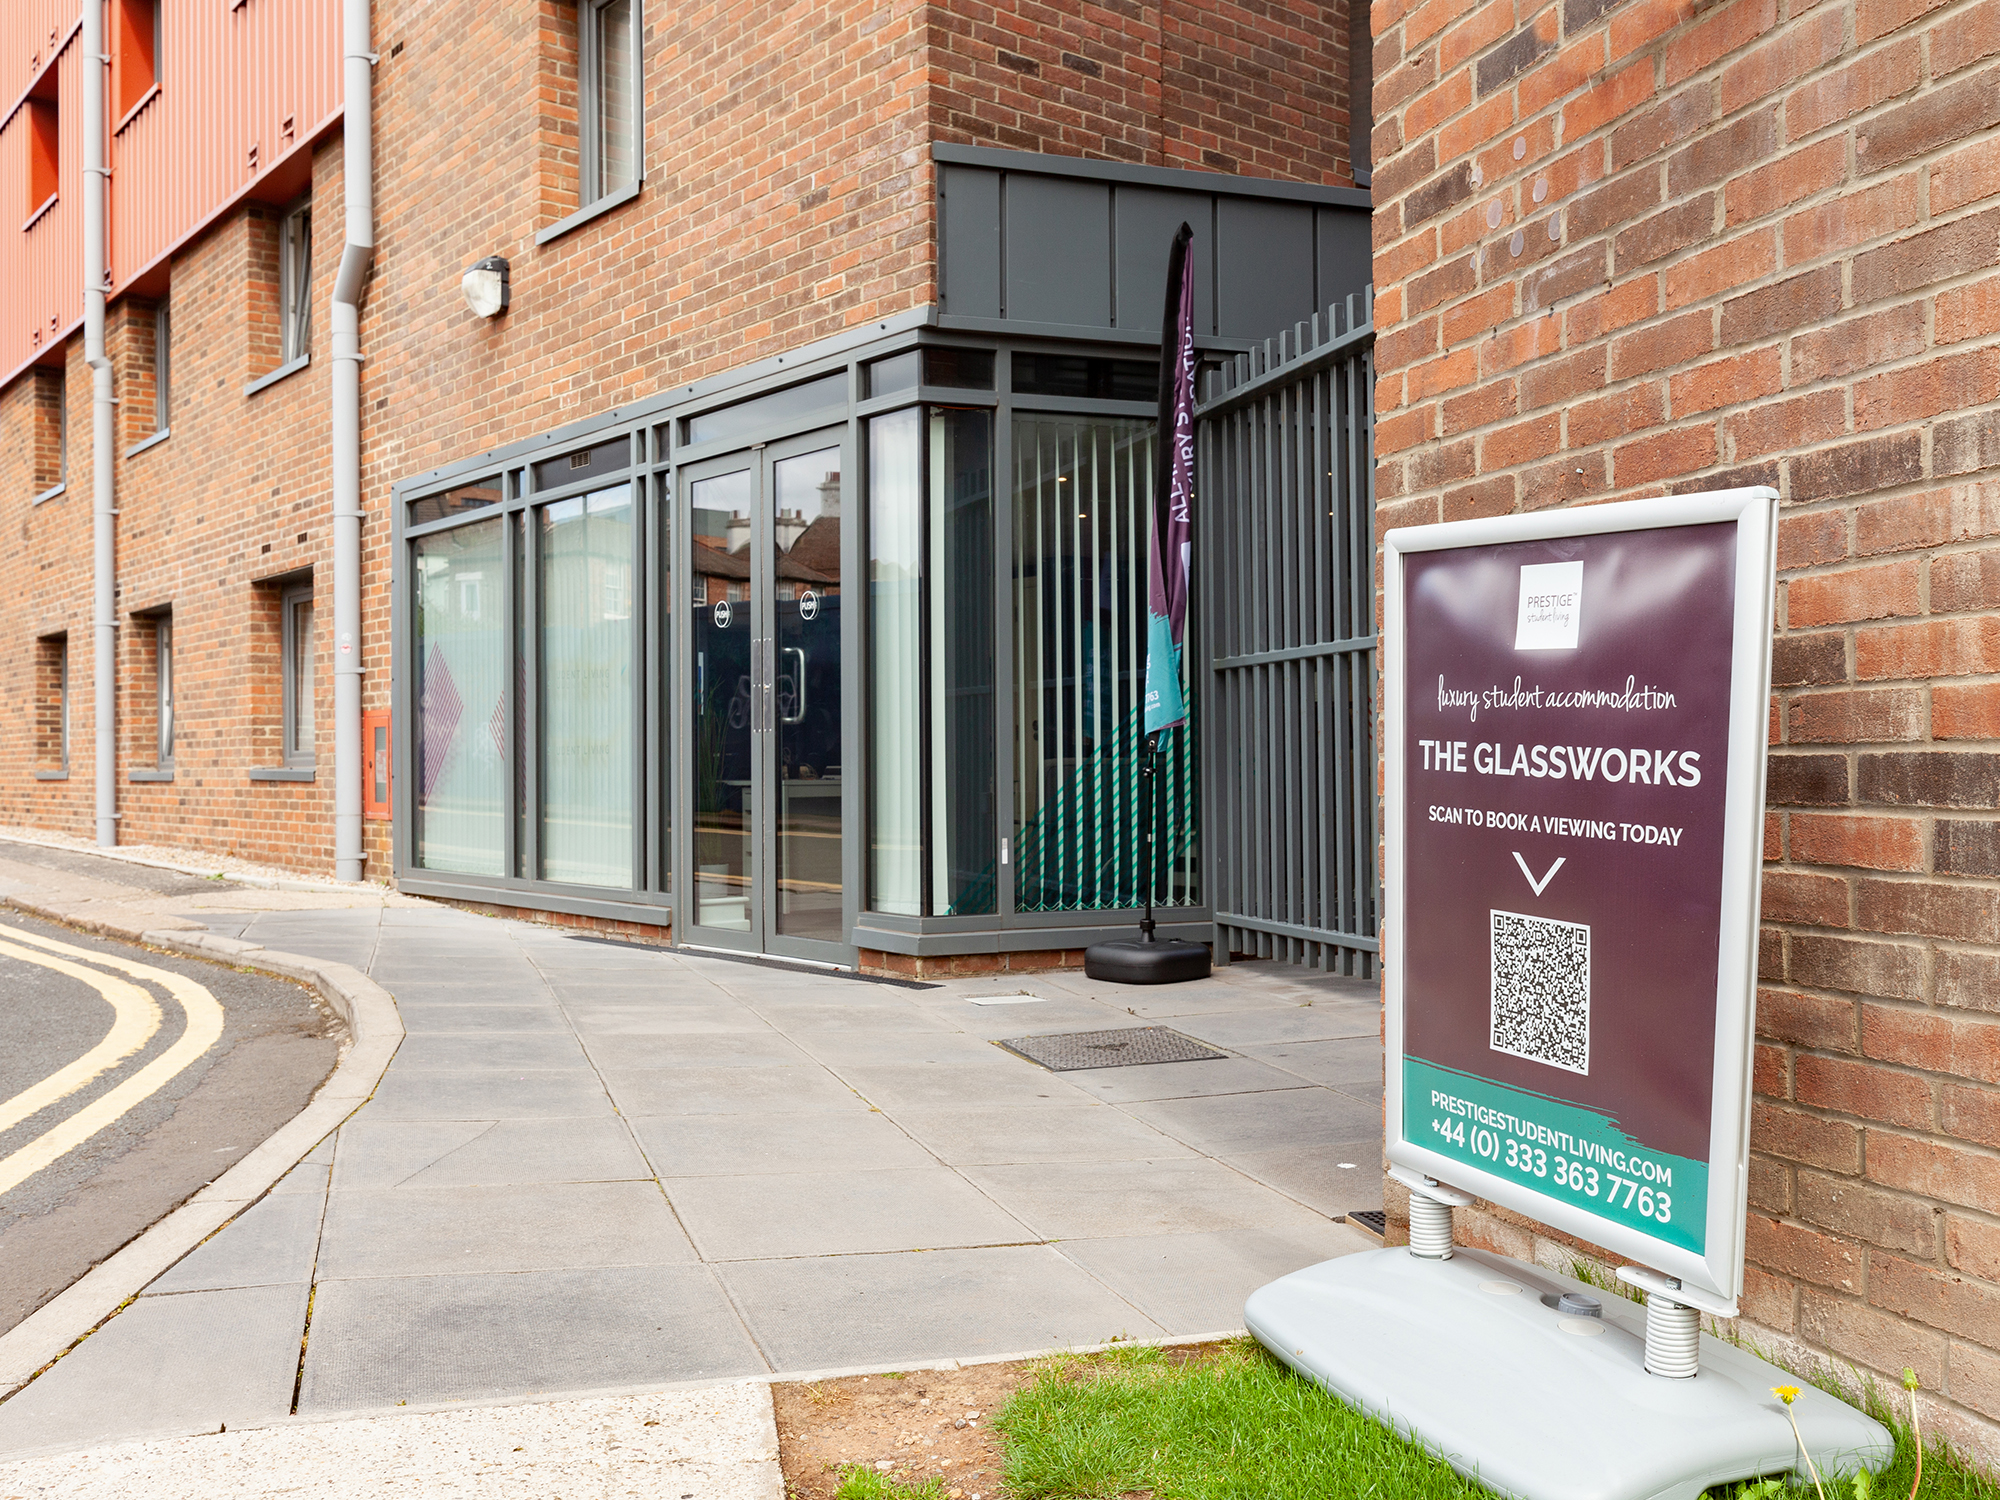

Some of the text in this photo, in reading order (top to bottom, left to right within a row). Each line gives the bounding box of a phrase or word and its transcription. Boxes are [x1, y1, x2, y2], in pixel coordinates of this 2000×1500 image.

[486, 262, 493, 270] 2
[801, 600, 817, 611] PUSH
[1526, 609, 1552, 624] student
[1527, 594, 1573, 608] PRESTIGE
[1438, 673, 1677, 723] luxury student accommodation
[1418, 739, 1701, 788] THE GLASSWORKS
[1428, 805, 1683, 846] SCAN TO BOOK A VIEWING TODAY
[1431, 1089, 1672, 1187] PRESTIGESTUDENTLIVING.COM
[1432, 1117, 1672, 1223] +44 (0) 333 363 7763
